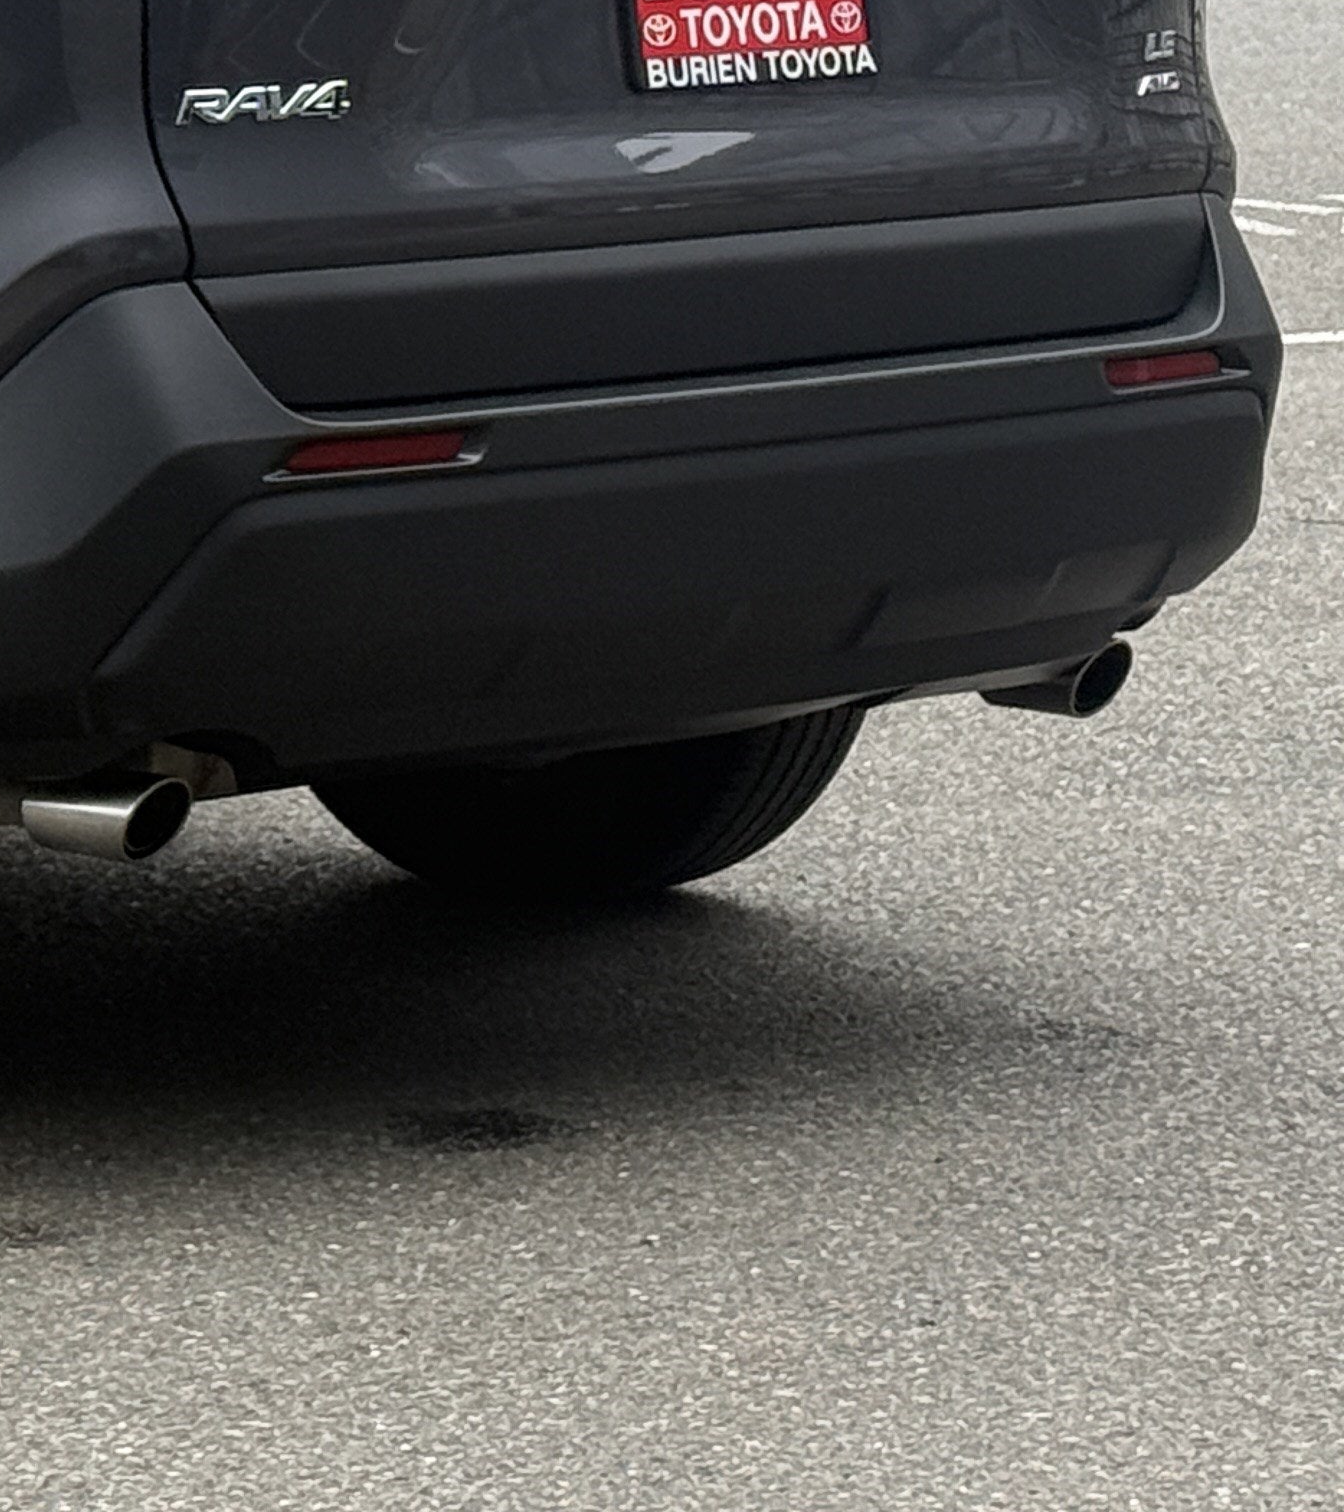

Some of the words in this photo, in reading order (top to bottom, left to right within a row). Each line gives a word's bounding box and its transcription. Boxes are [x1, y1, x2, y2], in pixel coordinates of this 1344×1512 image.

[679, 0, 828, 49] TOYOTA
[1144, 29, 1177, 62] LE
[646, 51, 758, 89] BURIEN
[764, 44, 879, 80] TOYOTA
[175, 79, 352, 126] RAV4
